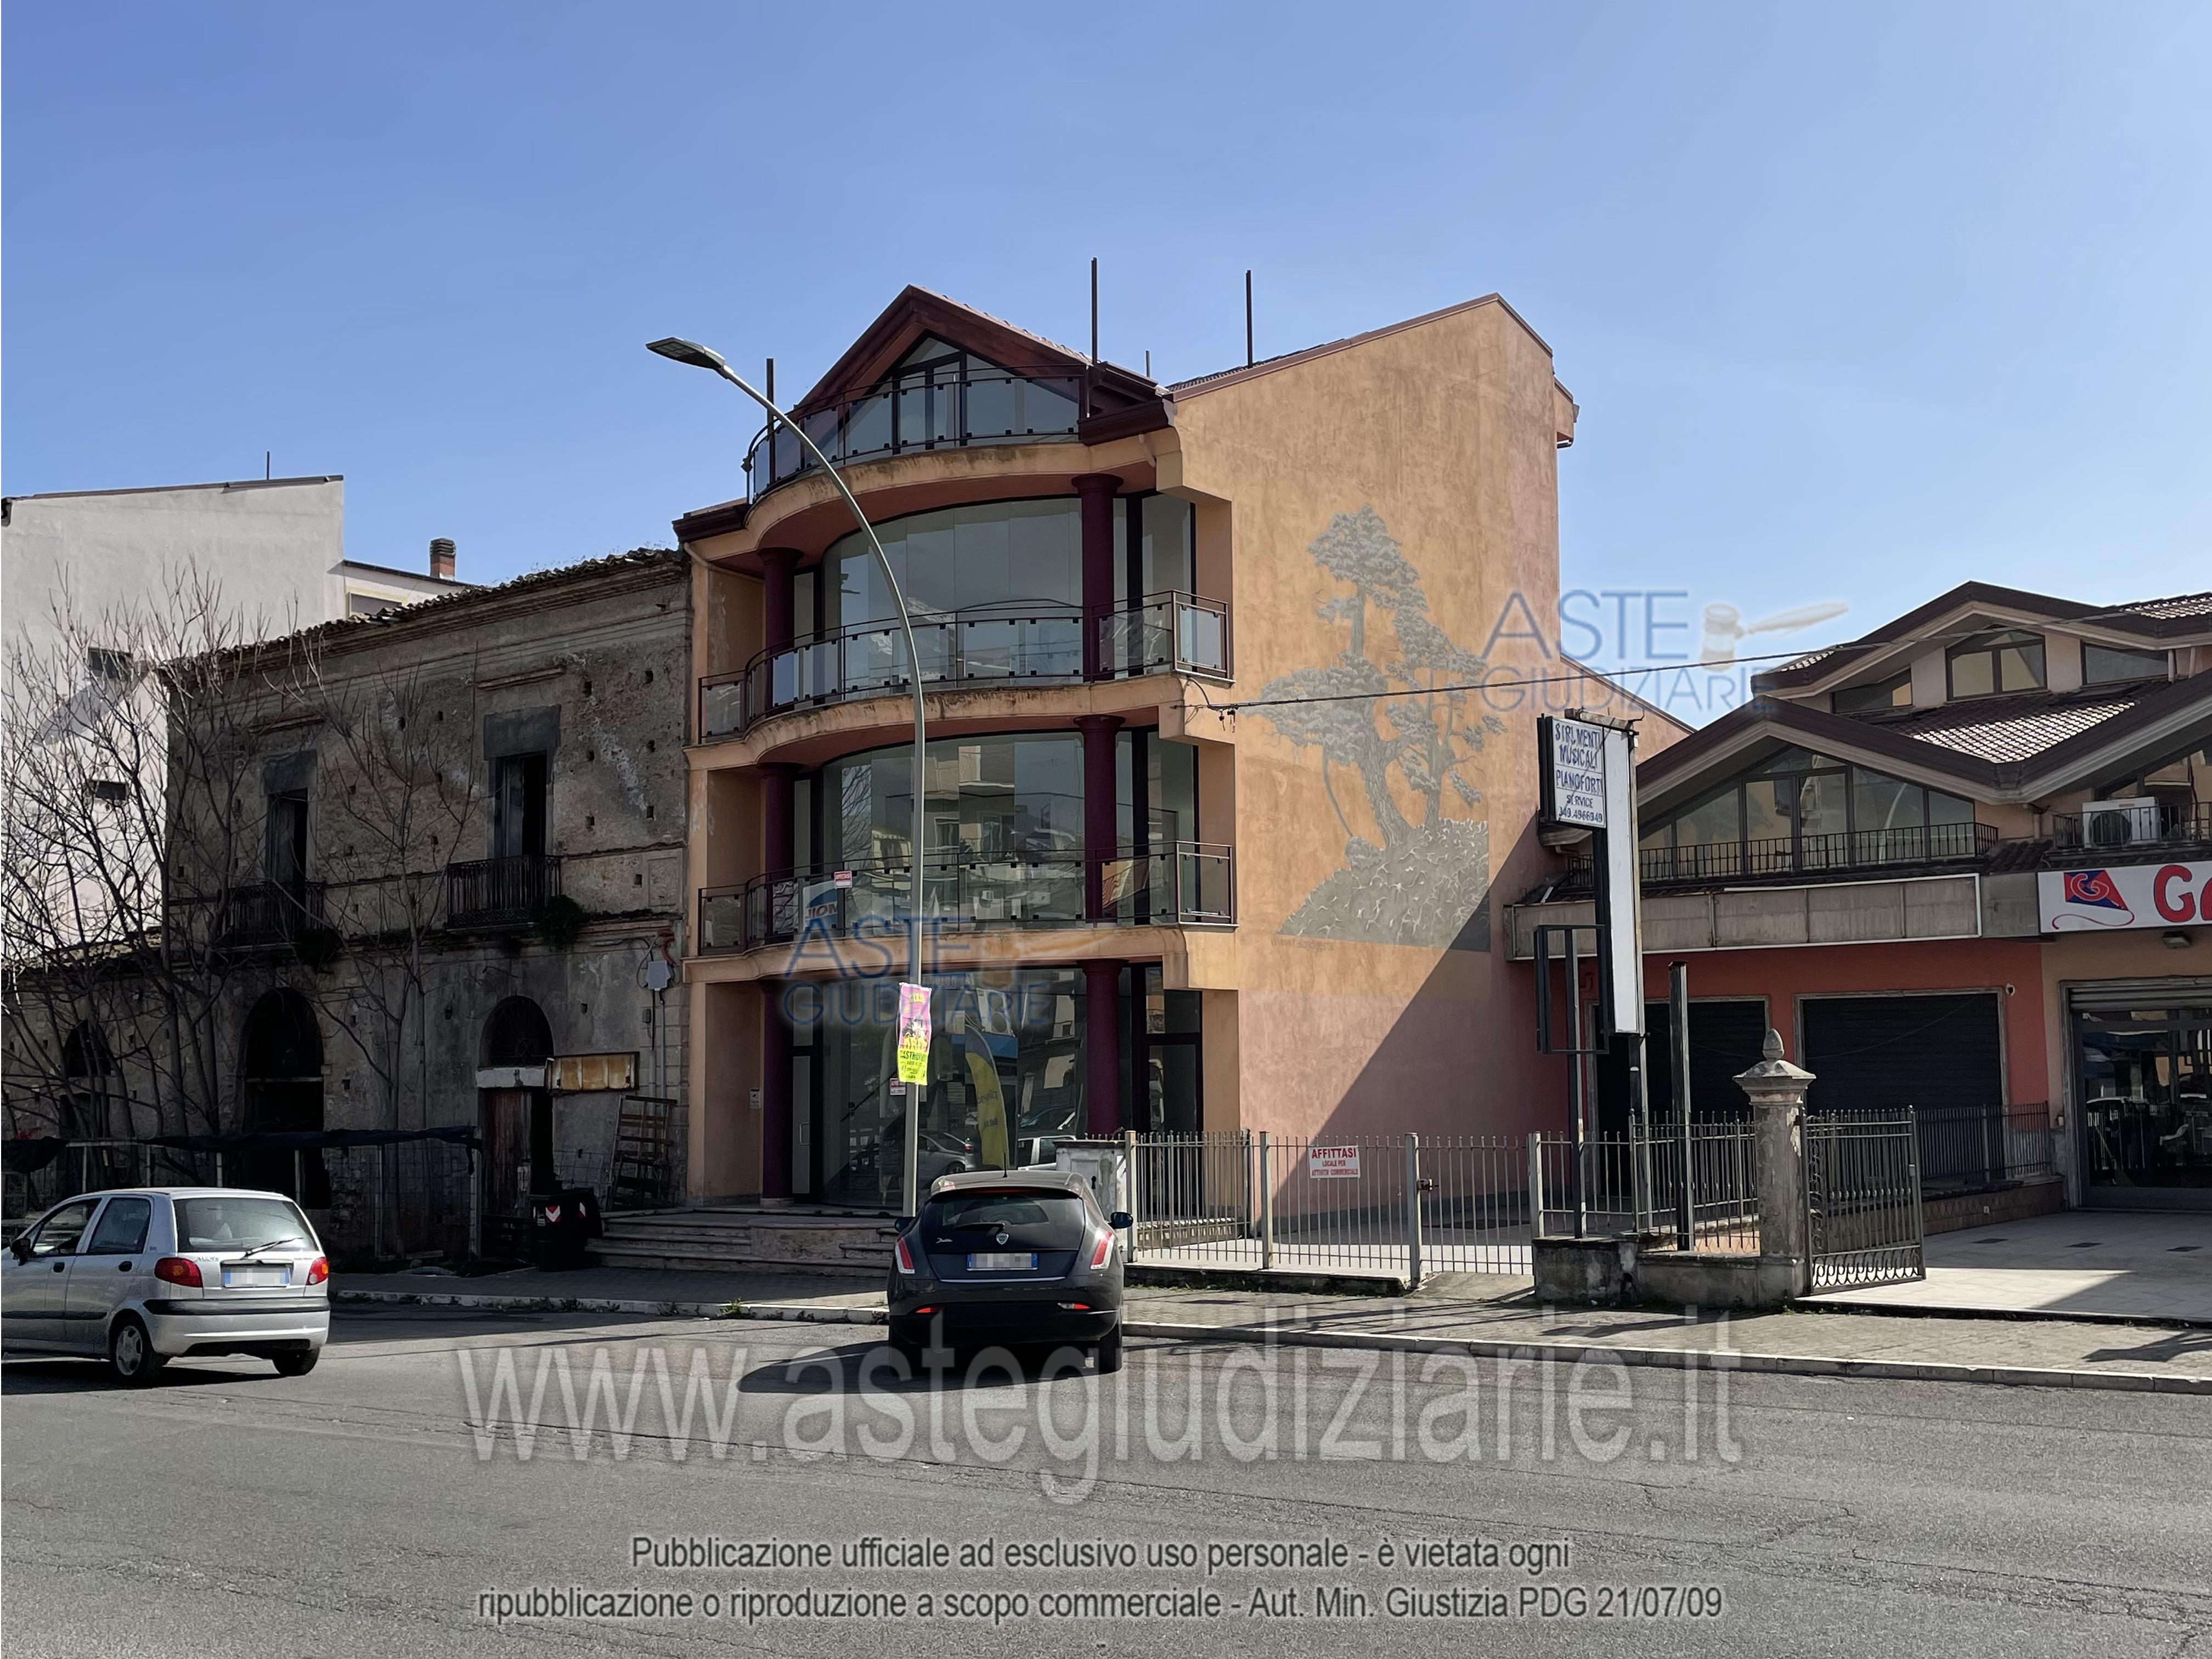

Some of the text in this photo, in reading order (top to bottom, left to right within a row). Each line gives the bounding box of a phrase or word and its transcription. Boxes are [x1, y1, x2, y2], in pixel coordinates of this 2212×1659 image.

[1559, 744, 1598, 770] MUSICALI
[1567, 794, 1593, 808] SERVICE
[1312, 1148, 1356, 1159] AFFITTASI
